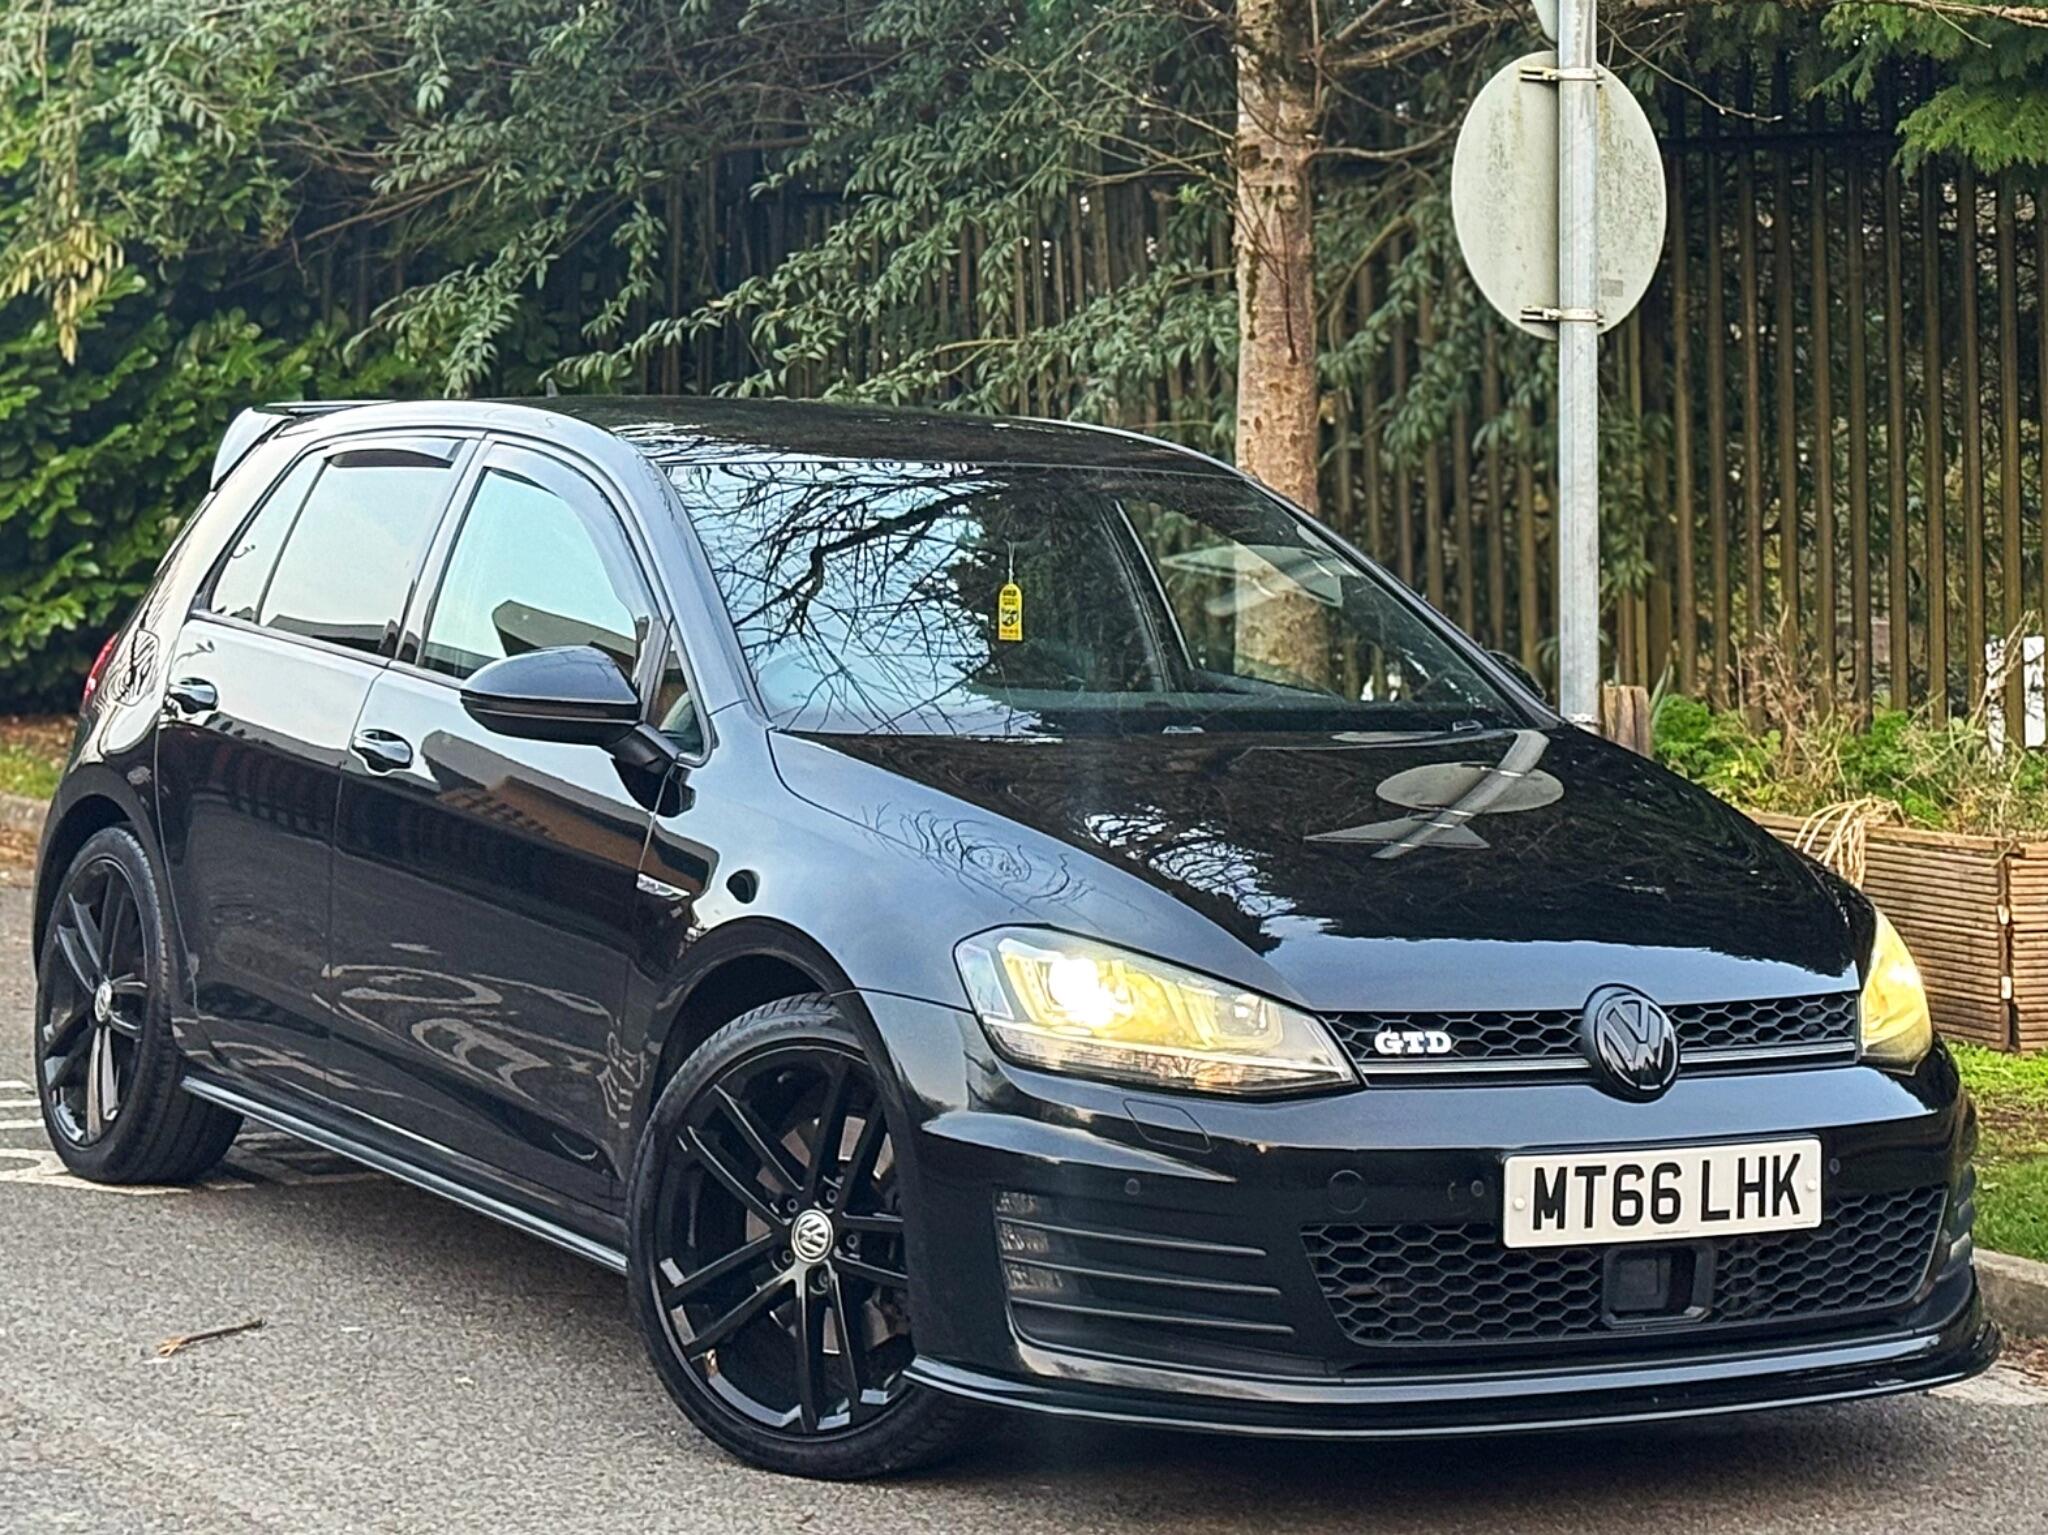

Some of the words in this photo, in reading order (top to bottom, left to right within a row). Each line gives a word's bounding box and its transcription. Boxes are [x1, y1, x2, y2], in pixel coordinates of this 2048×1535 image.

[1374, 1030, 1452, 1055] GTD
[1532, 1162, 1682, 1231] MT66
[1700, 1153, 1802, 1222] LHK
